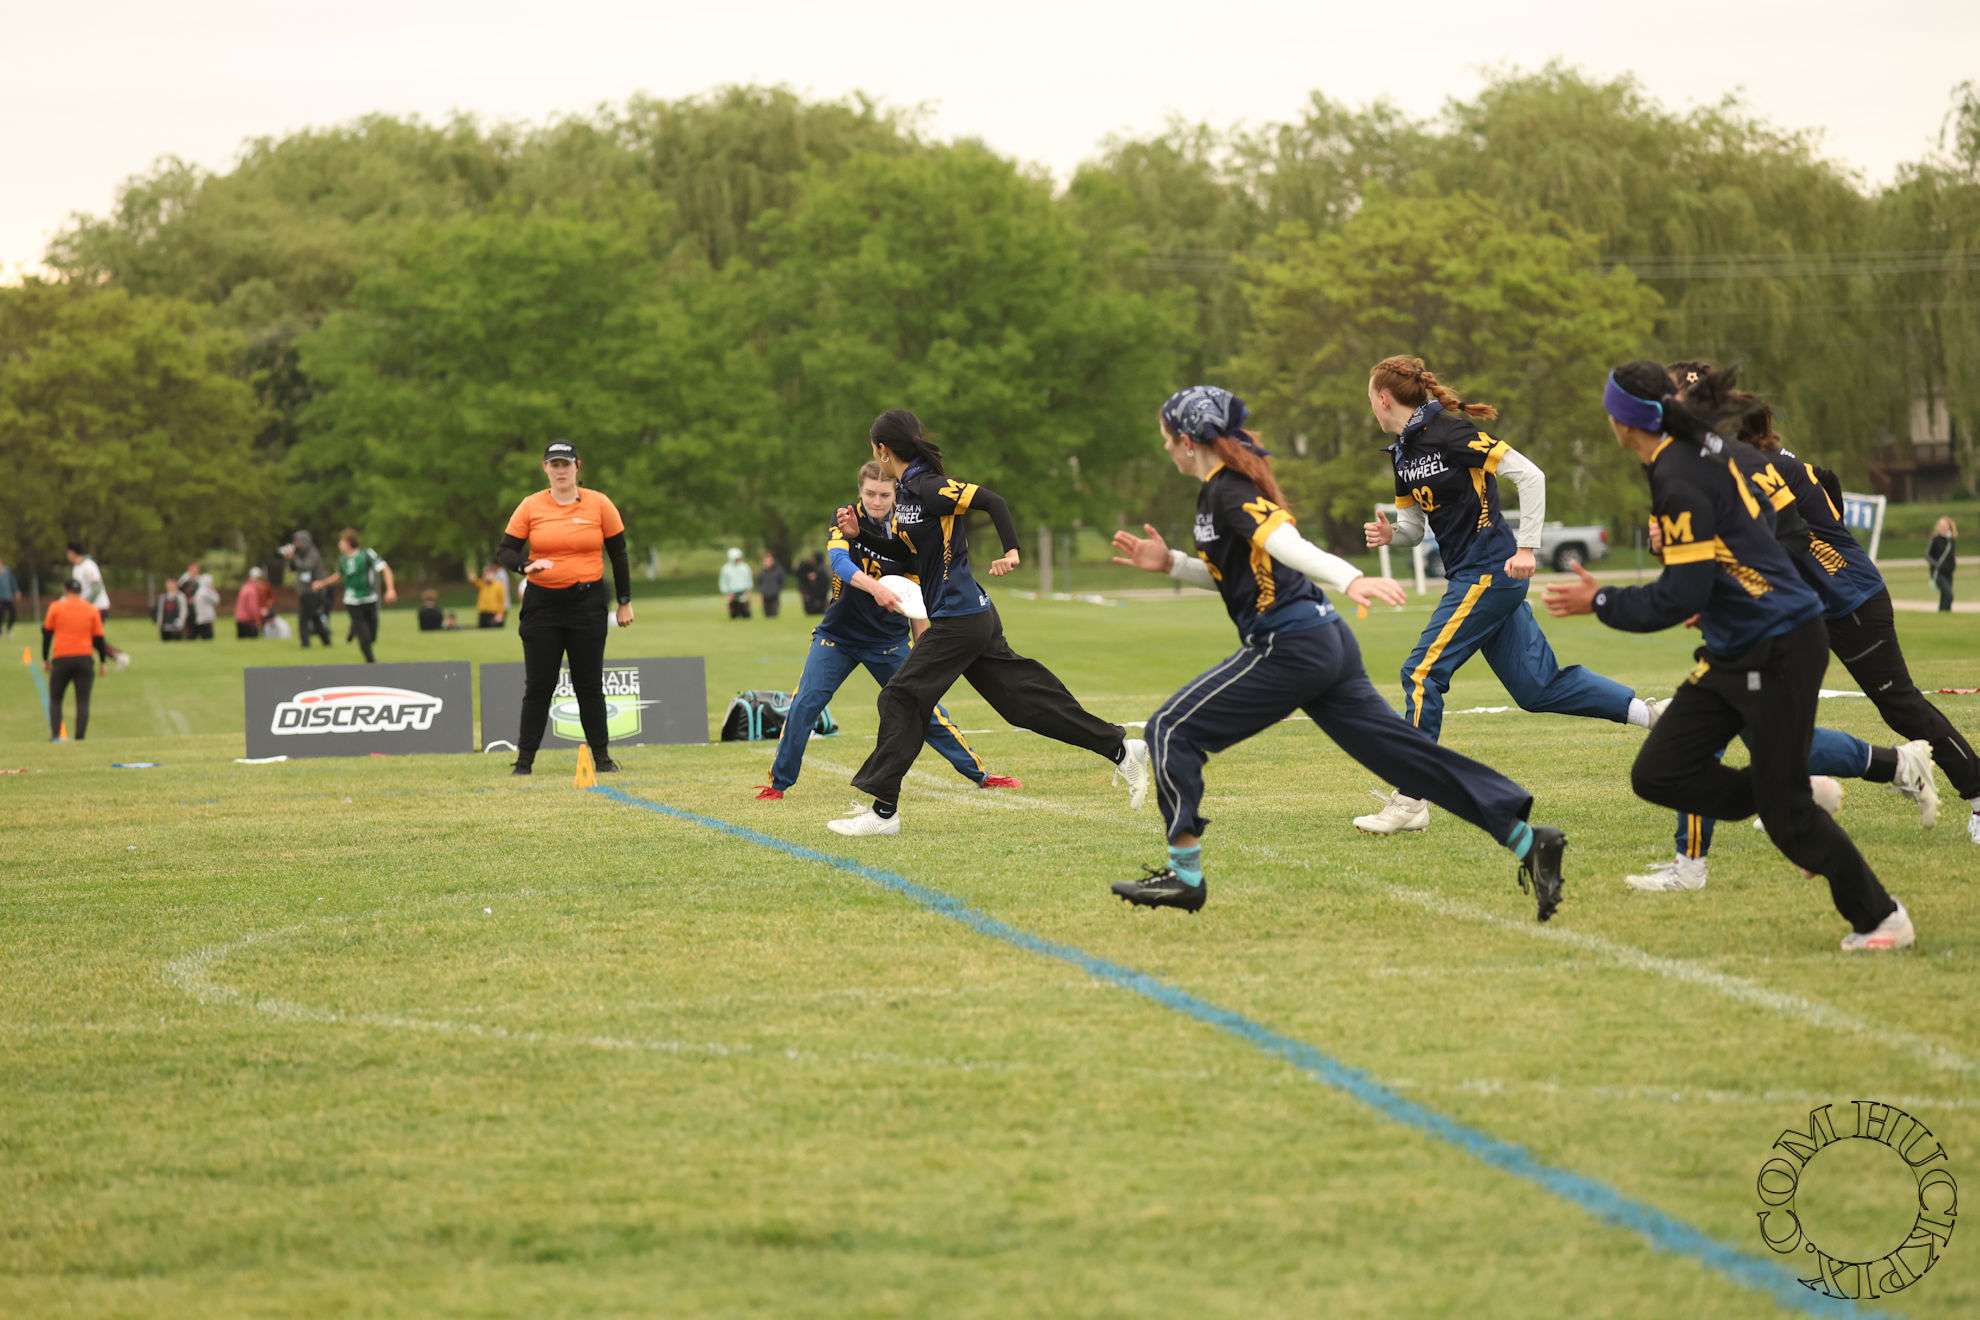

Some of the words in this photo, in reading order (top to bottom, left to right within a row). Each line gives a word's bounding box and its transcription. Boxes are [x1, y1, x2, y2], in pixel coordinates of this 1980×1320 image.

[1412, 485, 1442, 512] 82
[1660, 510, 1695, 546] M
[278, 703, 437, 729] DISCRAFT
